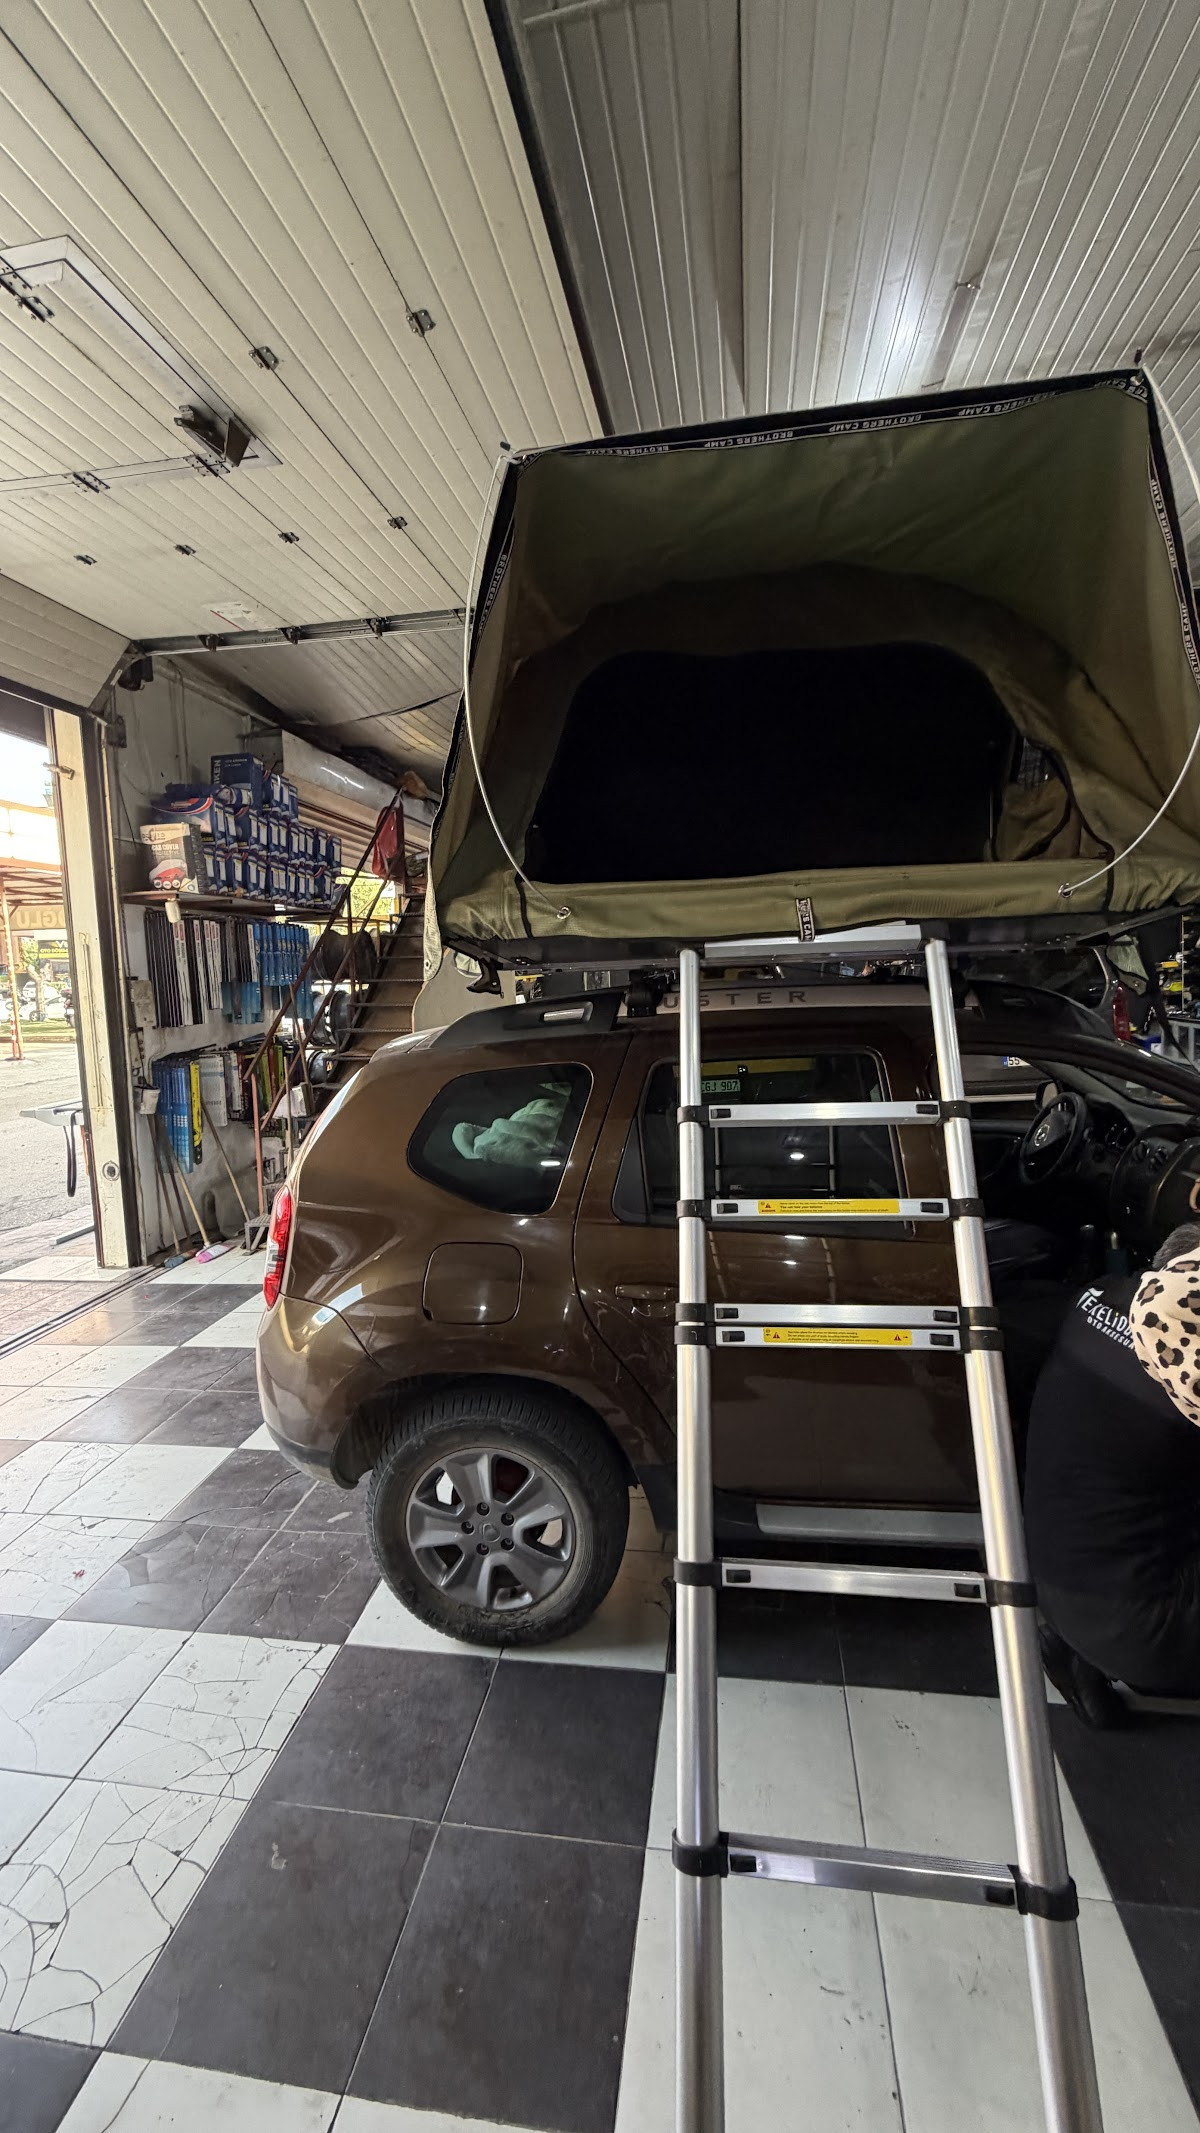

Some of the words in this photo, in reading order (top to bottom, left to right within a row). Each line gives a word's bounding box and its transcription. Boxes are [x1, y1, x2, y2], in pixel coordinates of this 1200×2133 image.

[957, 405, 991, 417] CAMP
[828, 421, 859, 432] CAMP
[862, 414, 922, 429] BROTHERS
[703, 439, 733, 448] CAMP
[736, 431, 794, 445] BROTHERS
[616, 445, 669, 455] BROTHERS
[1150, 479, 1163, 510] CAMP
[1159, 512, 1177, 568] BROTHERS
[486, 554, 508, 607] BROTHERS
[663, 990, 806, 1009] USTER
[721, 1080, 738, 1091] 907
